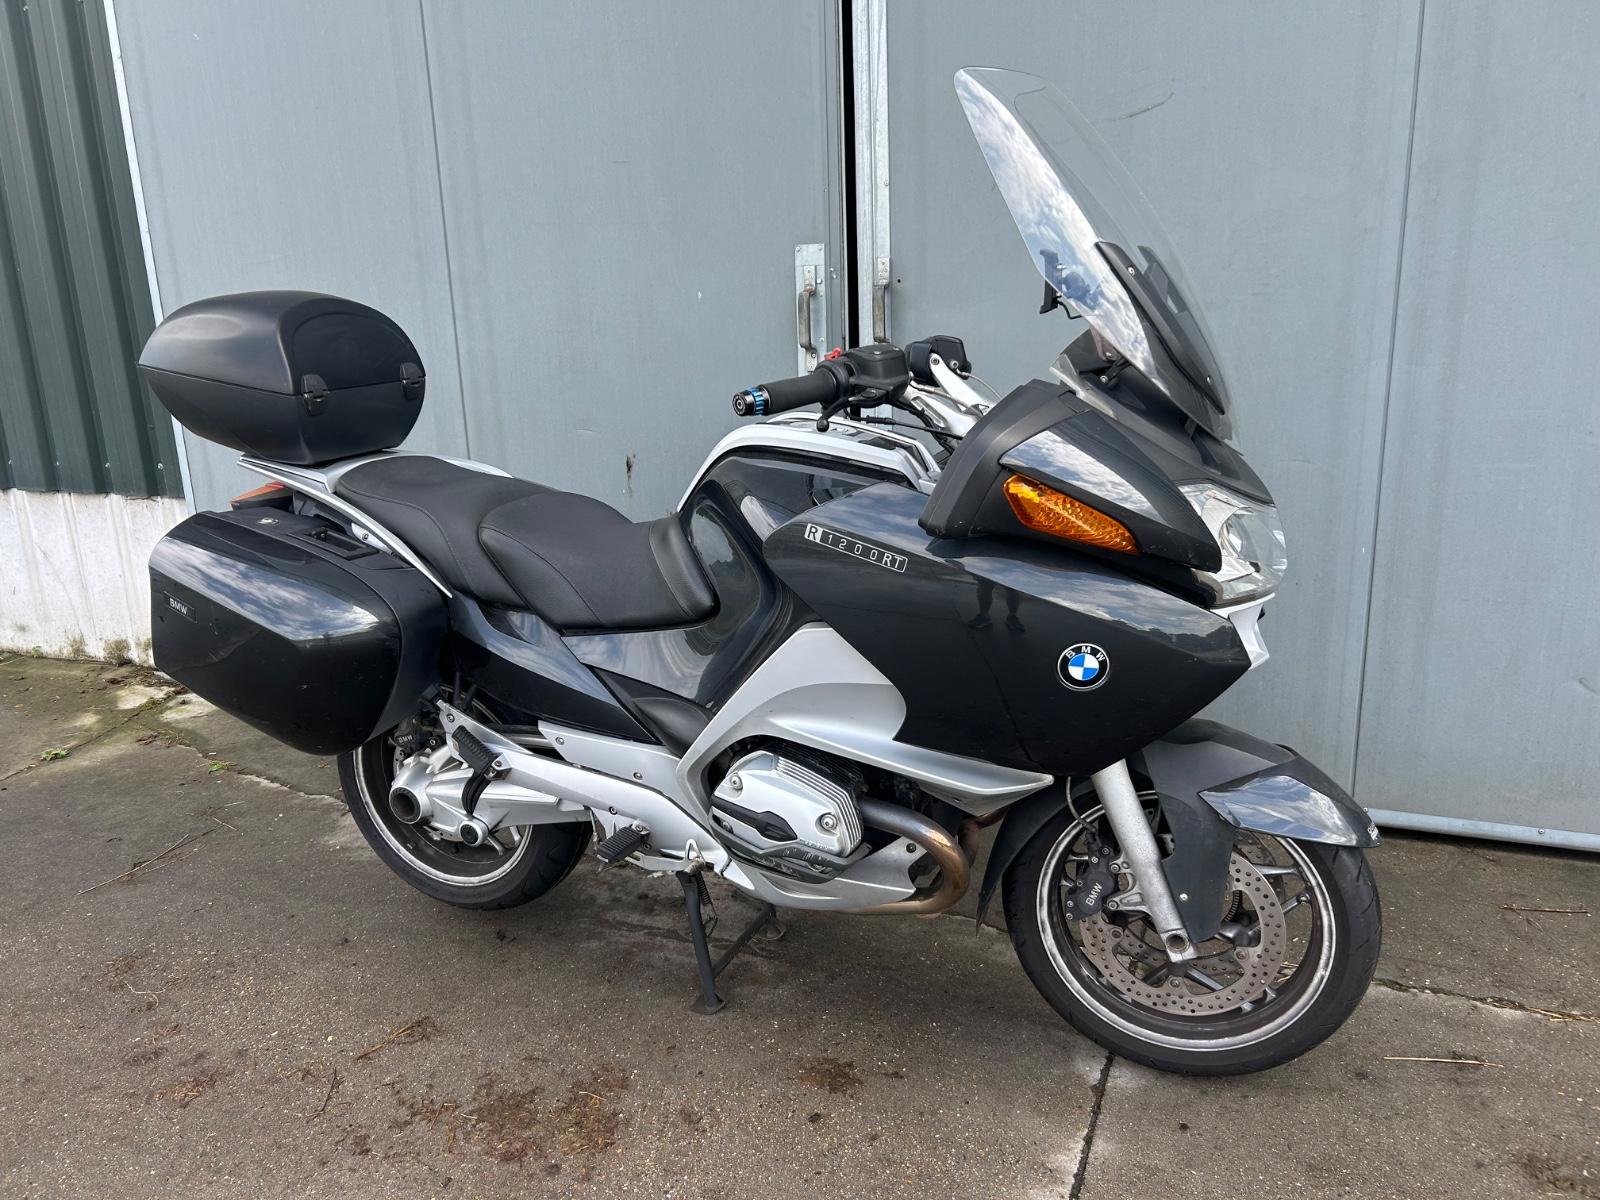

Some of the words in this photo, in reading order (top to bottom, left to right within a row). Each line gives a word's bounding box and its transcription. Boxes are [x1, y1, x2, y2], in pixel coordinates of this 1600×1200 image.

[807, 525, 819, 541] R
[169, 597, 188, 615] BMW
[1065, 645, 1106, 662] BMW
[398, 734, 413, 744] BMW
[1085, 882, 1103, 906] BMW
